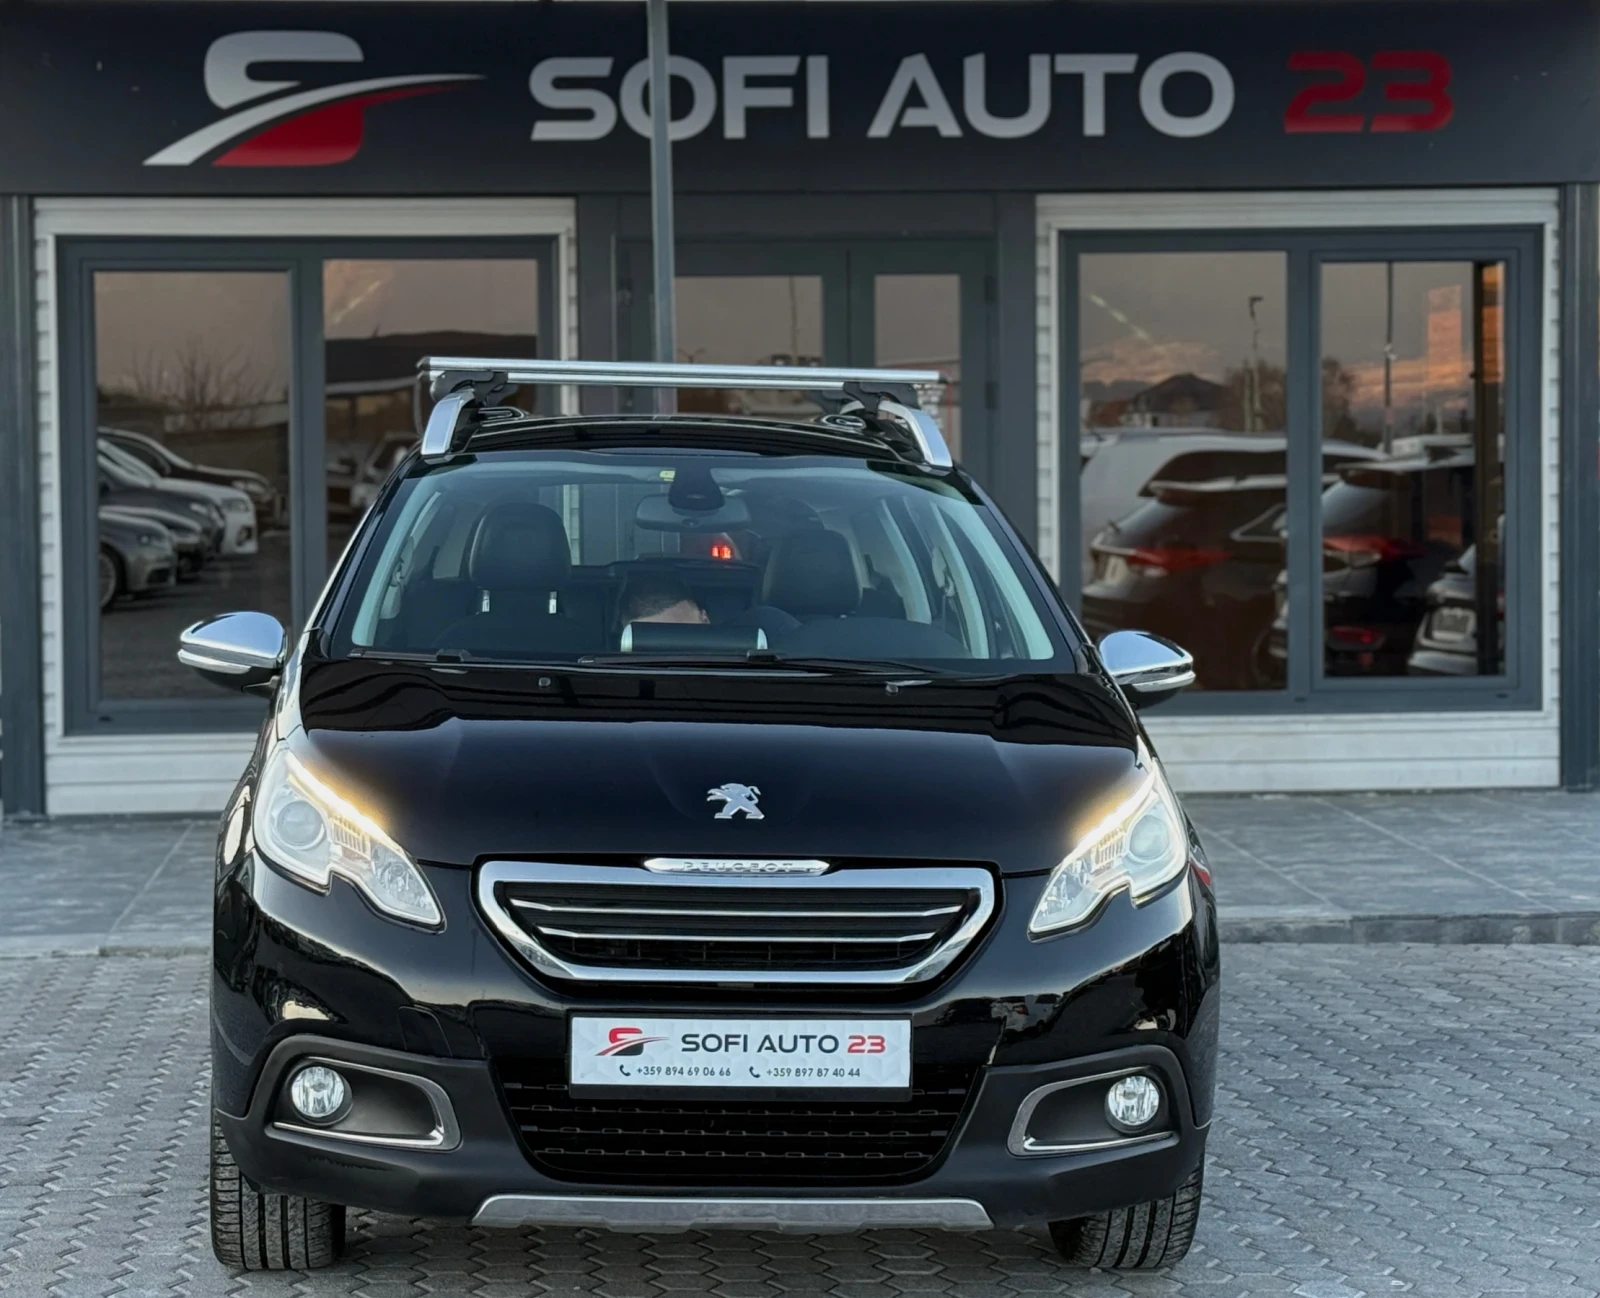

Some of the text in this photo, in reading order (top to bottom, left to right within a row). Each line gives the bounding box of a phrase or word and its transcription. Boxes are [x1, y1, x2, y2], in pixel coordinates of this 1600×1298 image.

[528, 50, 1454, 141] SOFI AUTO 23
[681, 1033, 886, 1054] SOFI AUTO 23
[637, 1065, 731, 1077] +359 894 69 06 66
[766, 1067, 861, 1078] +359 897 87 40 44
